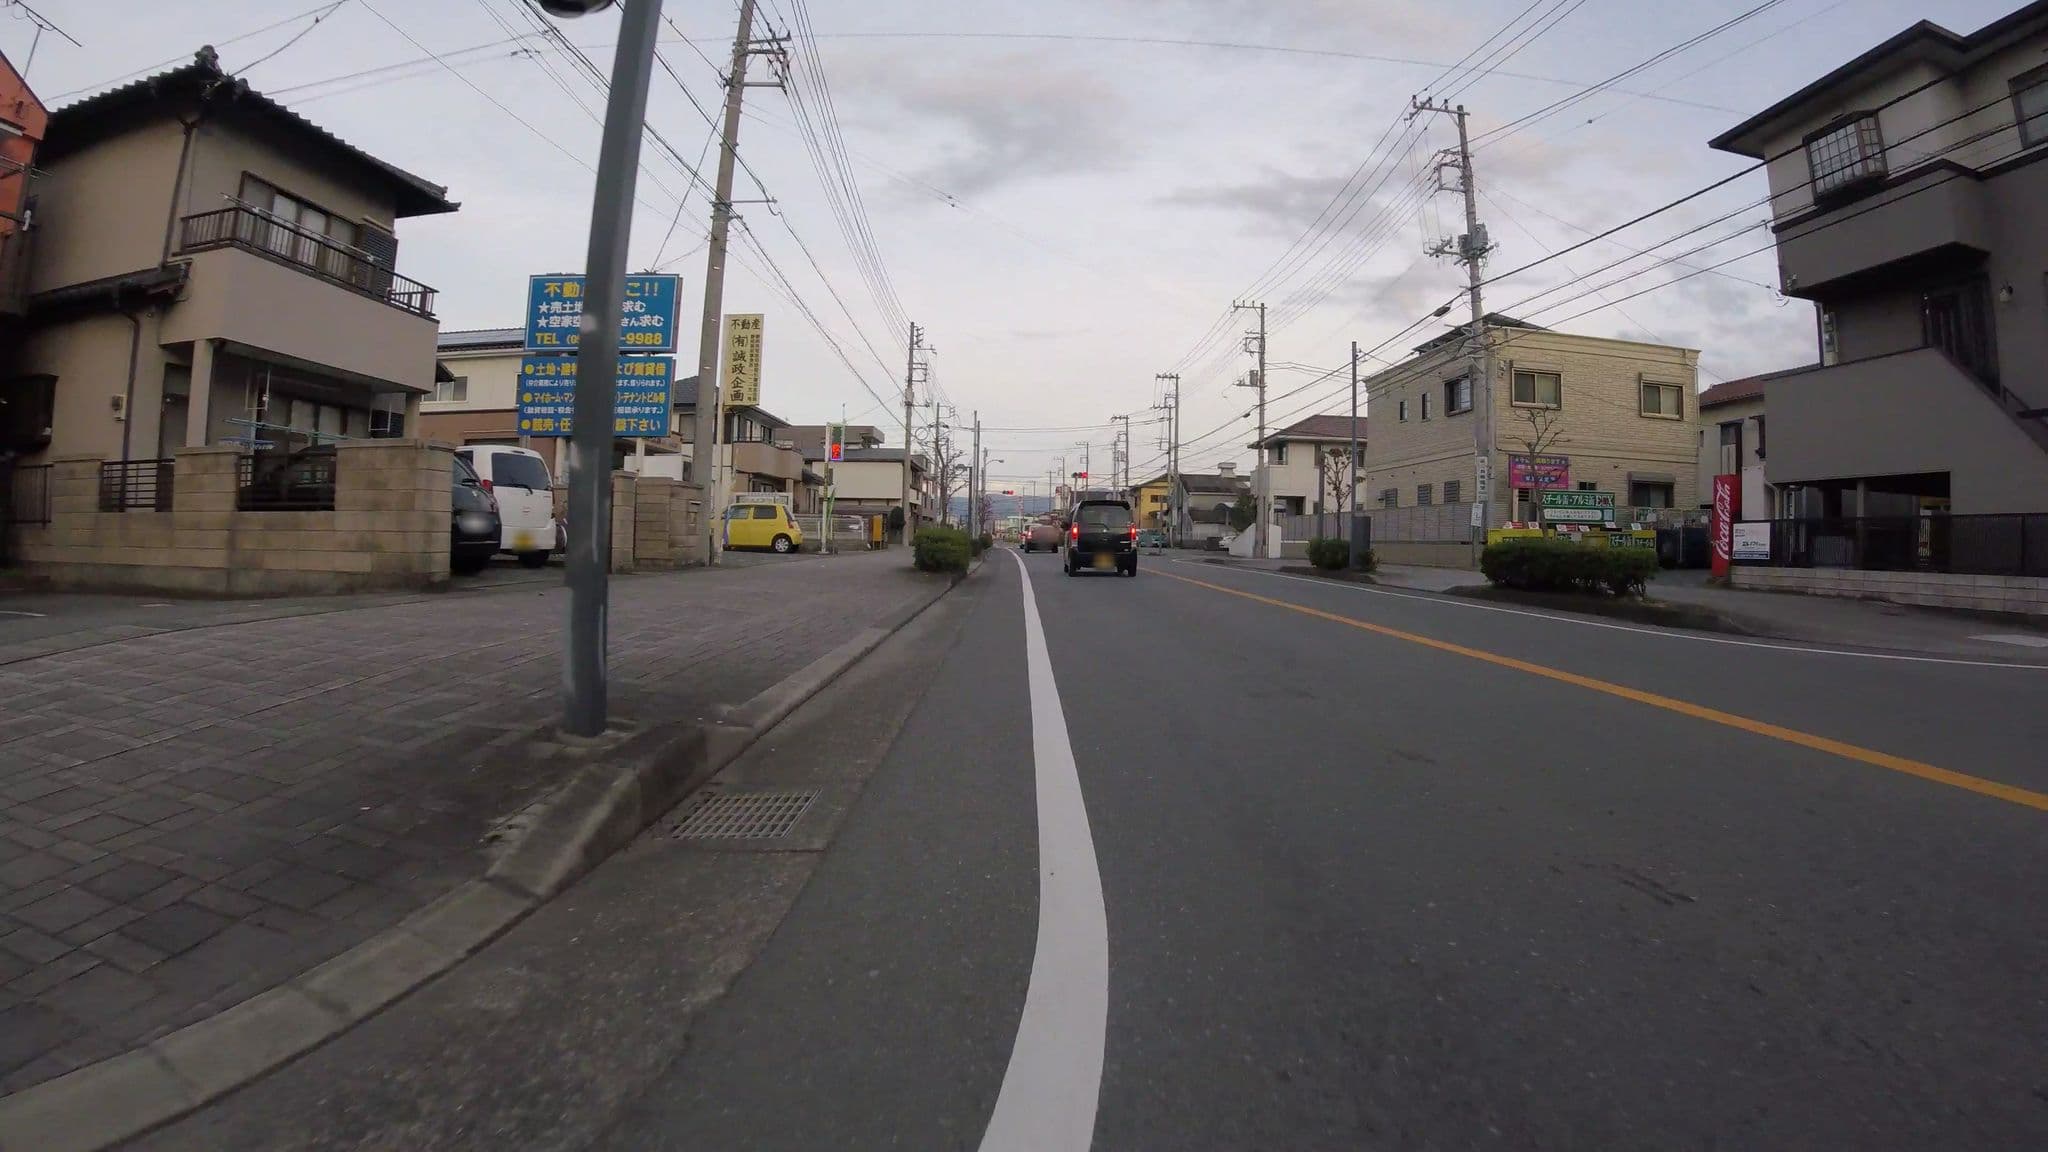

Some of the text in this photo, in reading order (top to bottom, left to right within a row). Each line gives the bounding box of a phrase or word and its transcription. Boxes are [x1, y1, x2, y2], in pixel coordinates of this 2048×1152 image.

[544, 281, 585, 298] 不動
[622, 300, 647, 313] 求む
[731, 318, 761, 331] 不動産
[535, 332, 560, 345] TEL
